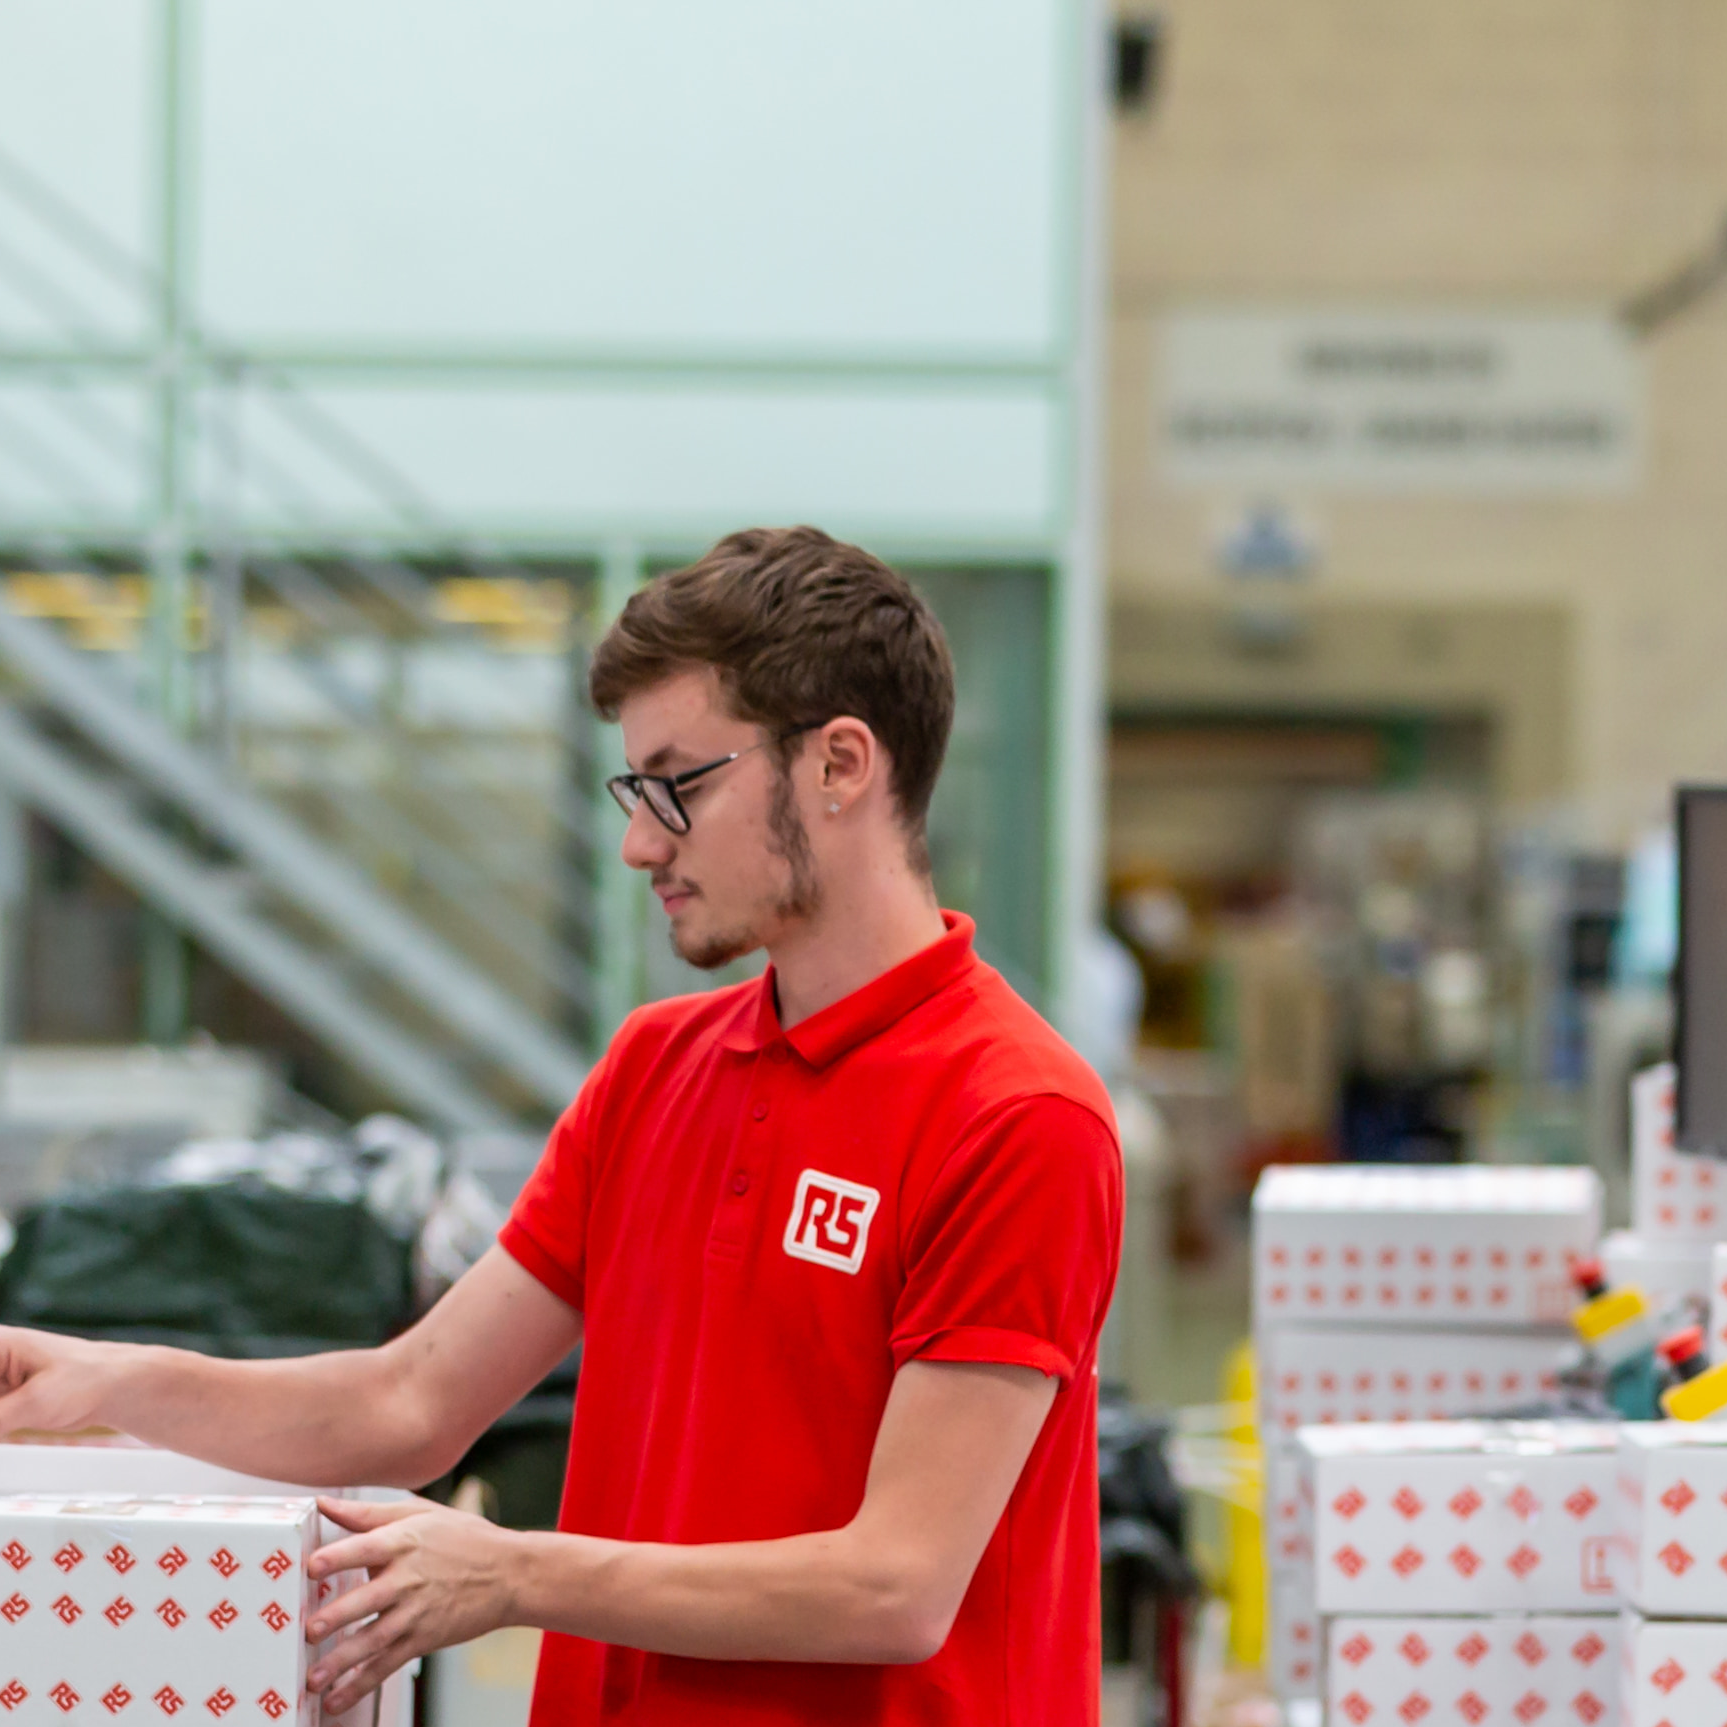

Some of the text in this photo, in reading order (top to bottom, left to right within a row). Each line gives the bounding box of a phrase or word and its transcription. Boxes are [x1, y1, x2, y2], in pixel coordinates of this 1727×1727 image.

[792, 1182, 869, 1261] RS
[0, 1540, 32, 1572] RS
[53, 1543, 85, 1573] RS
[104, 1544, 137, 1575] RS
[157, 1545, 189, 1577] RS
[209, 1547, 240, 1579] RS
[261, 1549, 293, 1581] RS
